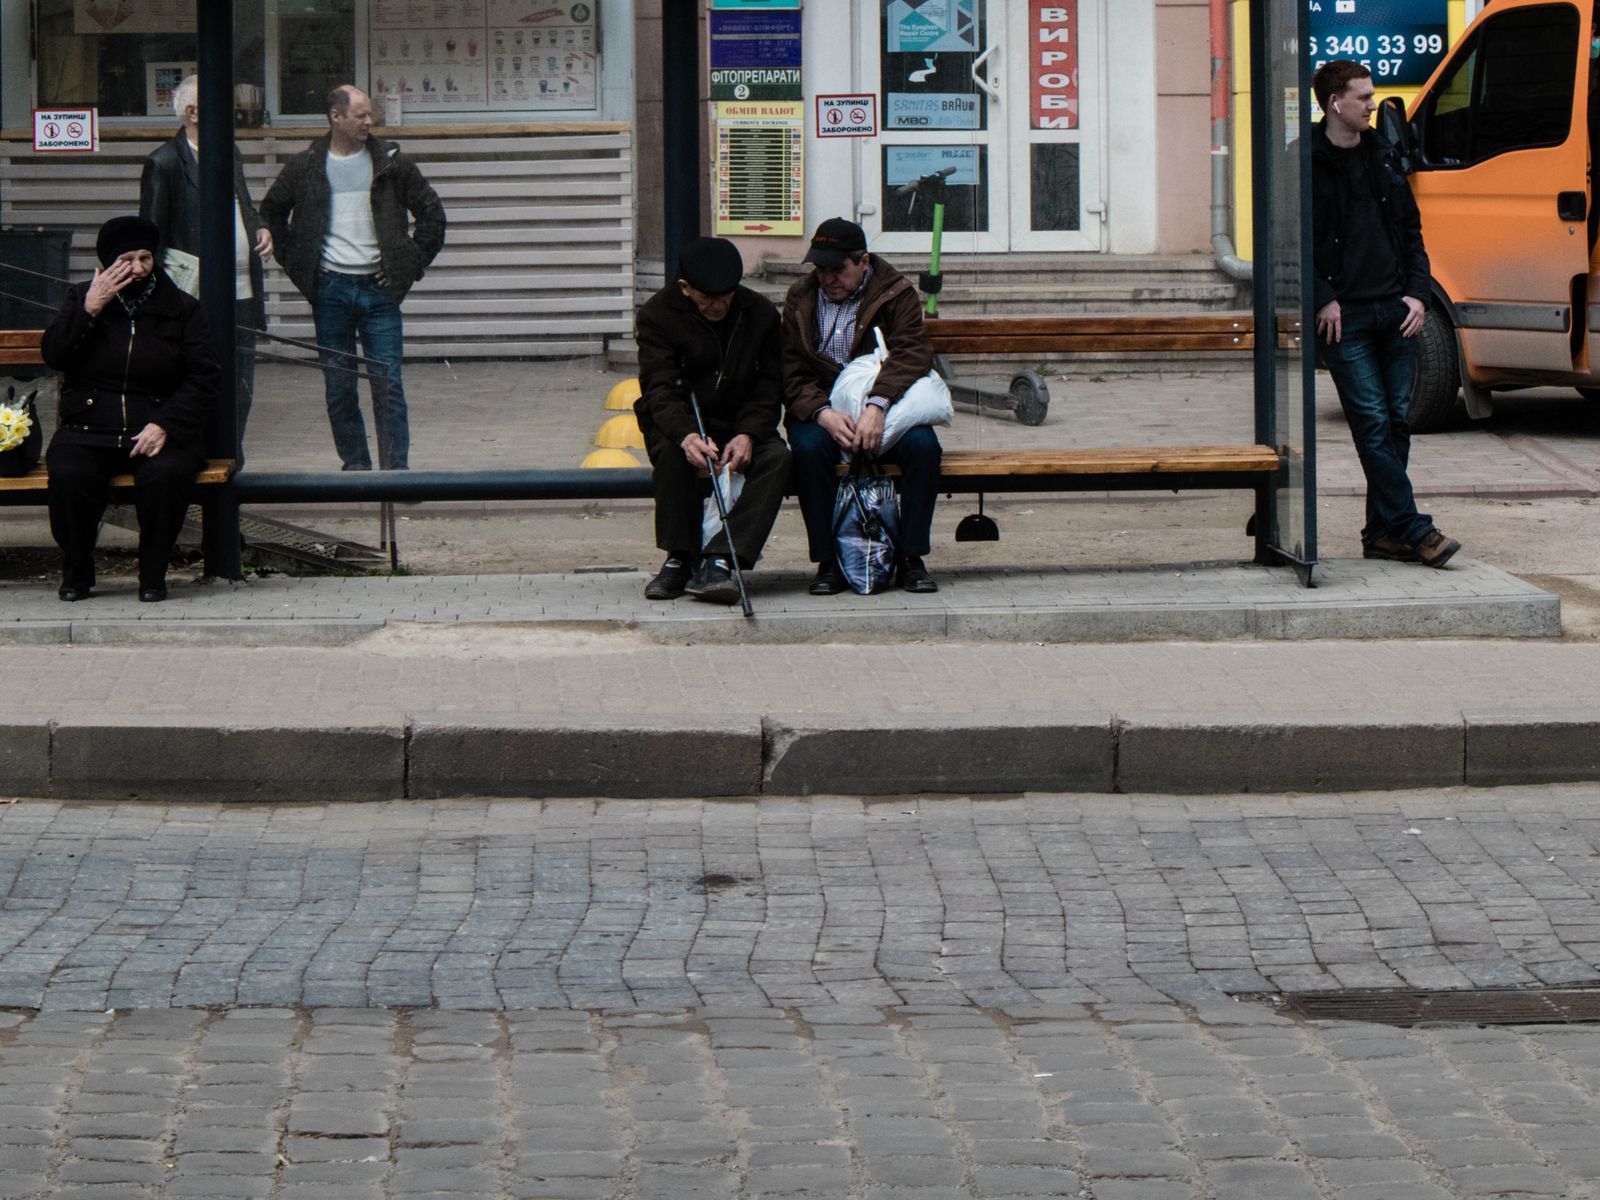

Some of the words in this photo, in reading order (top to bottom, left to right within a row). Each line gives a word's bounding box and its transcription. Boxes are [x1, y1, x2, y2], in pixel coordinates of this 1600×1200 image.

[1325, 35, 1369, 55] 340
[1377, 35, 1406, 54] 33
[1413, 34, 1443, 54] 99
[1377, 59, 1403, 76] 97
[711, 70, 801, 83] ФІТОПРЕПАРАТИ
[737, 86, 746, 98] 2
